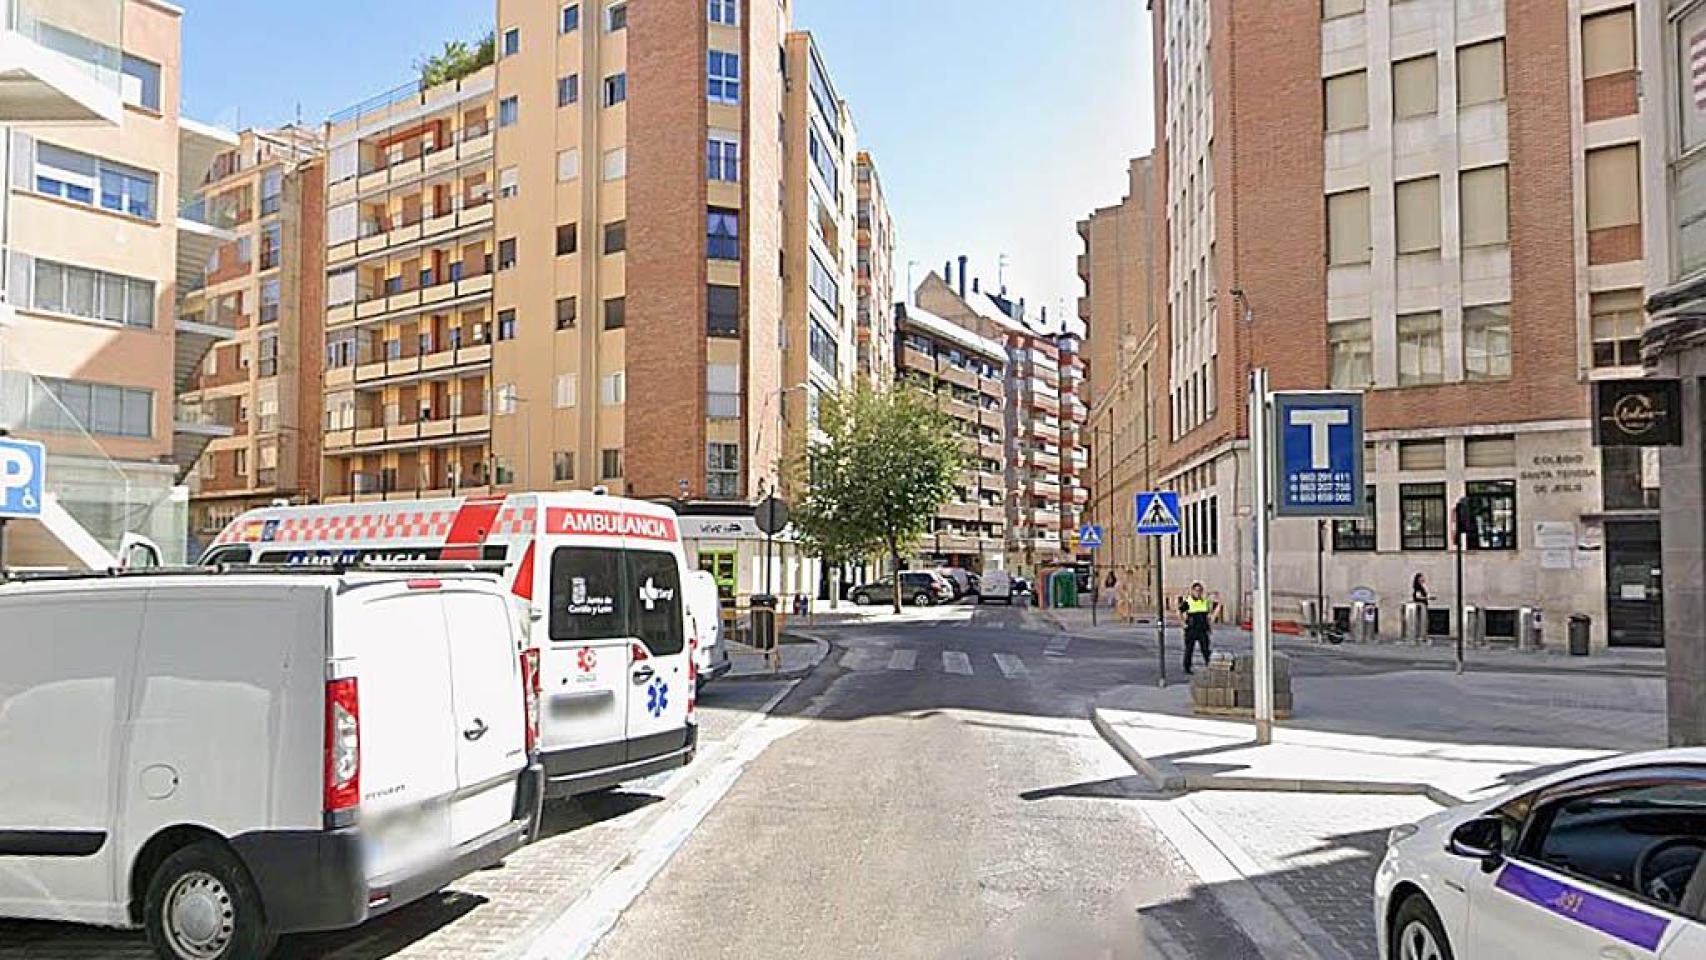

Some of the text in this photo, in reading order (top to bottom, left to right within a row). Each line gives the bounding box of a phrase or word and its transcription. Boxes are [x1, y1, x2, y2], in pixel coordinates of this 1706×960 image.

[1290, 409, 1349, 469] T
[0, 446, 33, 506] P
[561, 512, 669, 538] AMBULANCIA
